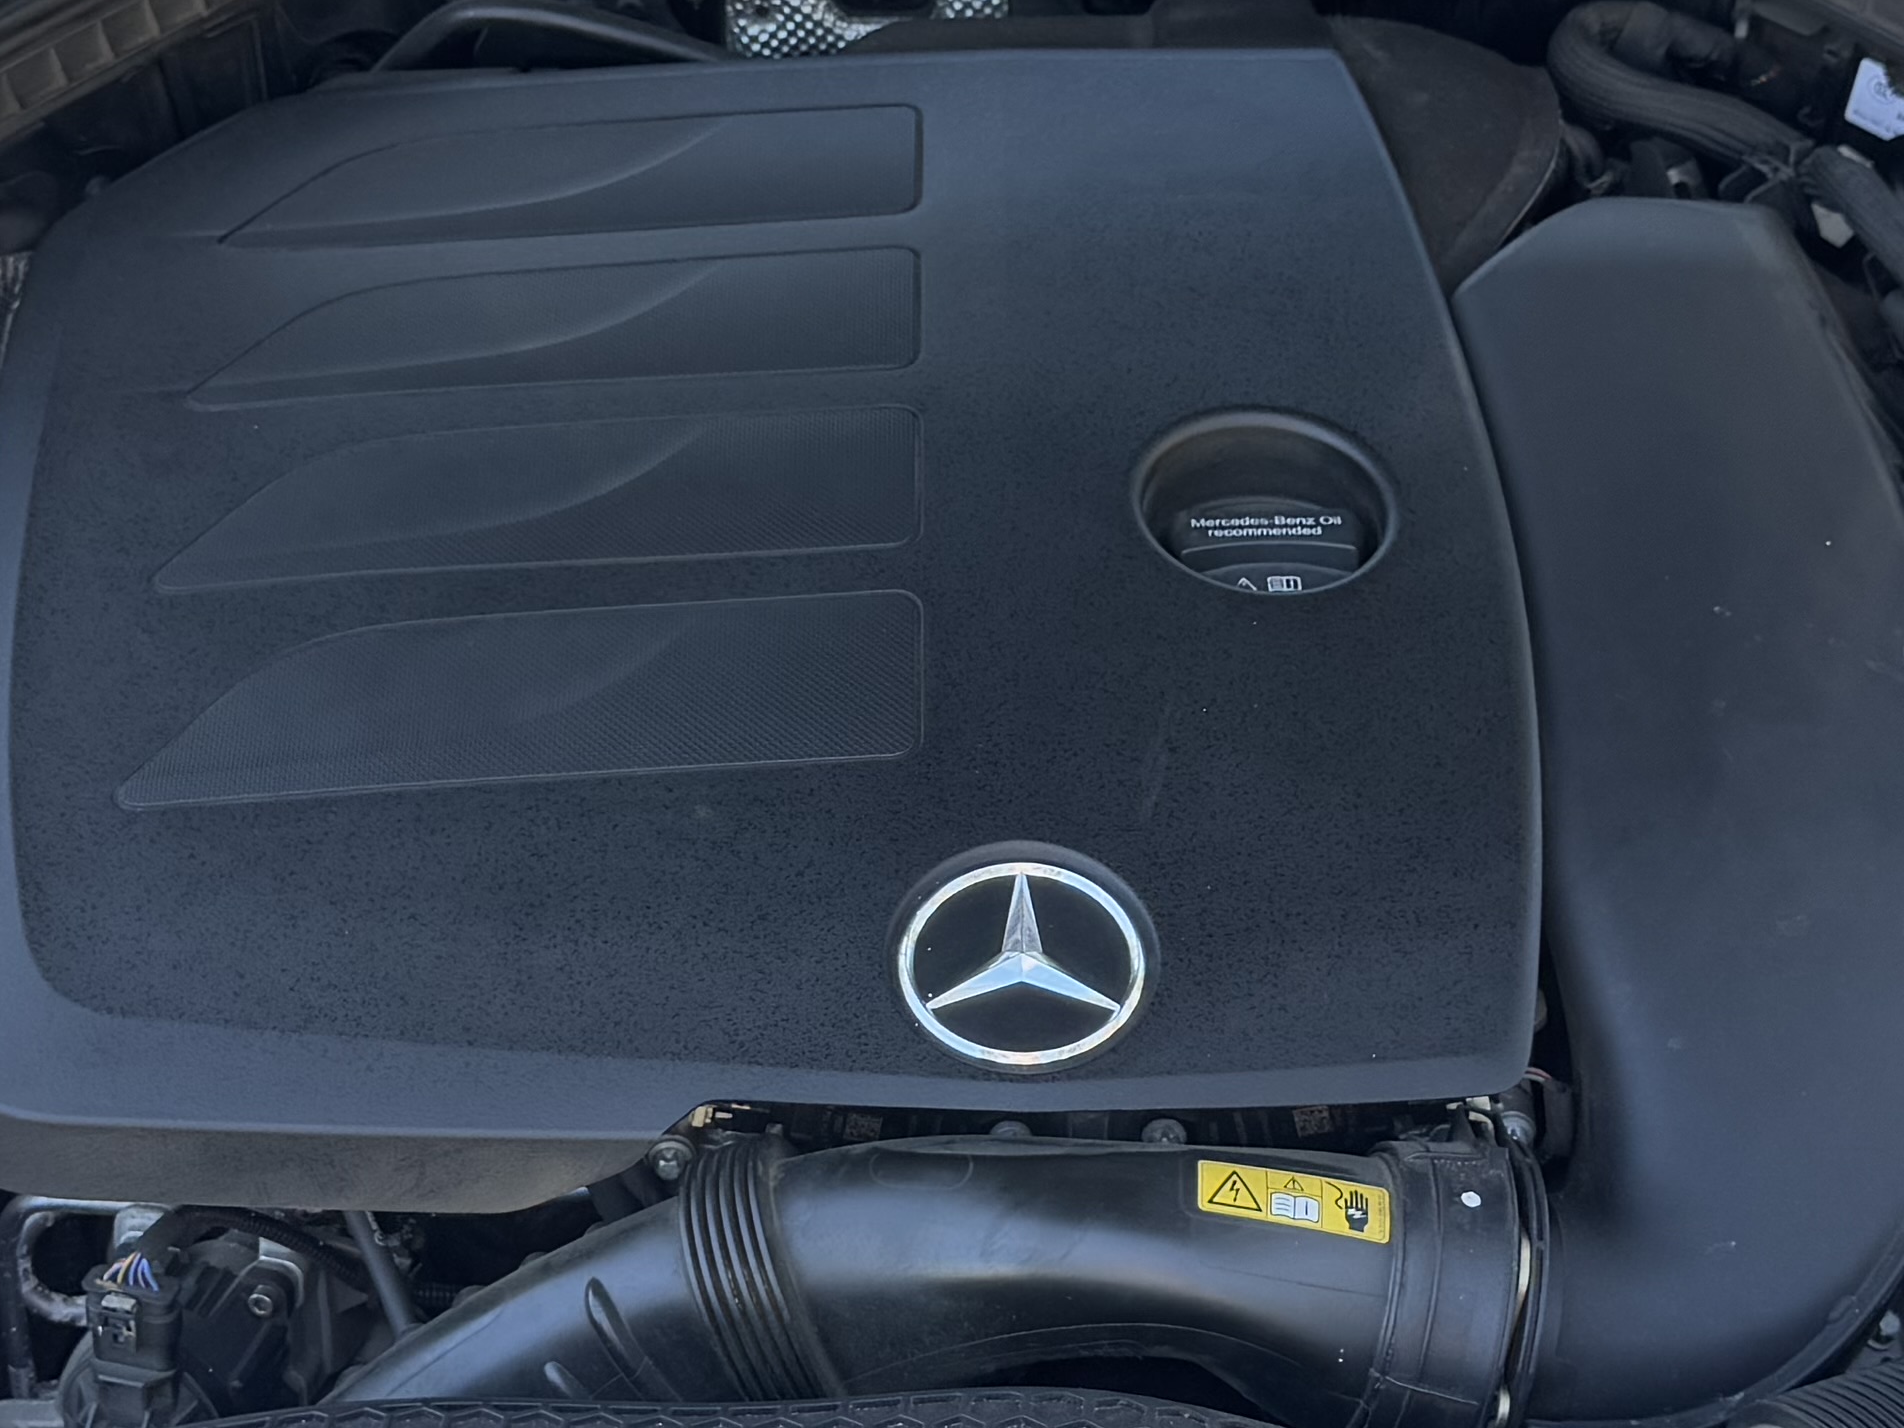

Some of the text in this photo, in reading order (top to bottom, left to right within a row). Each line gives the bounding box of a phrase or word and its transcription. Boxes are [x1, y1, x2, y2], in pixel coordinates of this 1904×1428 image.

[1190, 515, 1342, 528] Mercedes-Benz Oil
[1207, 526, 1322, 537] recommended
